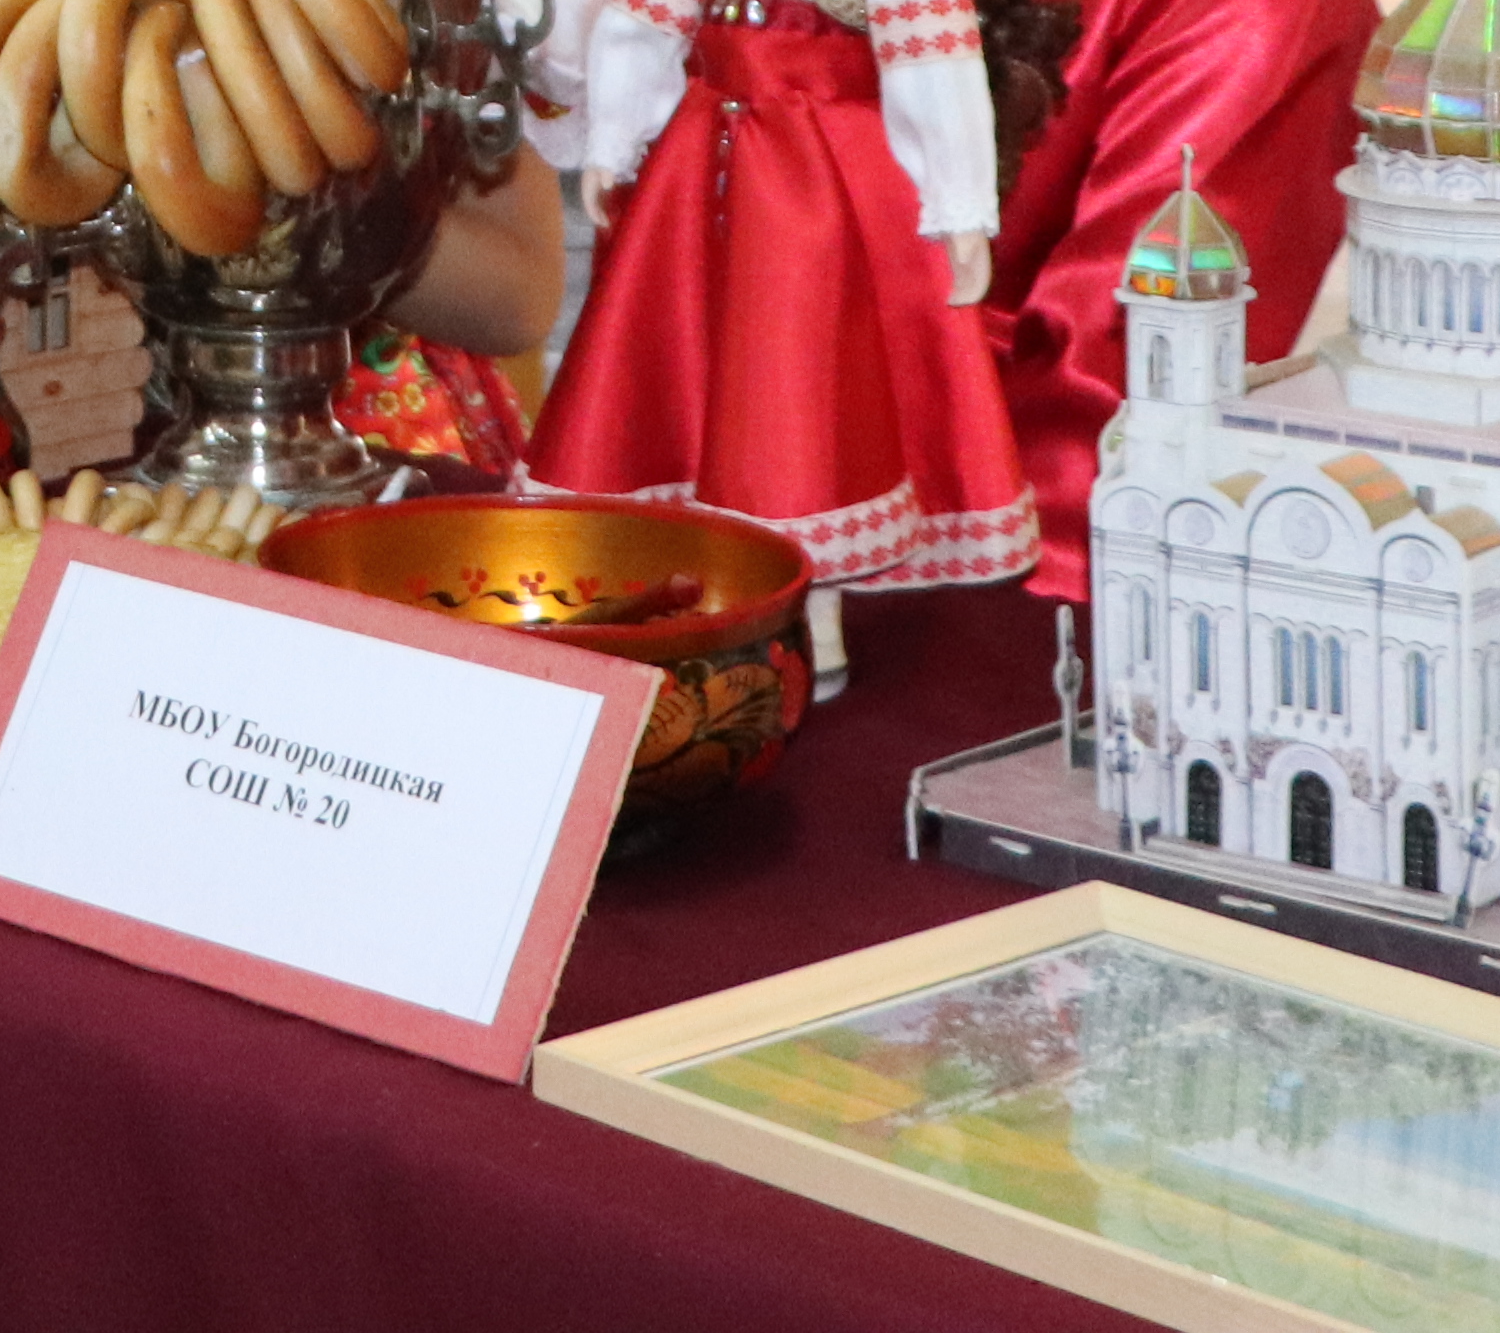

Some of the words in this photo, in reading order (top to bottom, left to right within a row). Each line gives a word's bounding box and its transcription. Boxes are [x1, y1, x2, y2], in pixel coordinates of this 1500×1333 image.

[128, 689, 231, 740] МБОУ
[233, 719, 445, 804] Богородицкая
[185, 758, 271, 807] СОШ
[273, 783, 308, 819] №
[314, 795, 351, 830] 20
